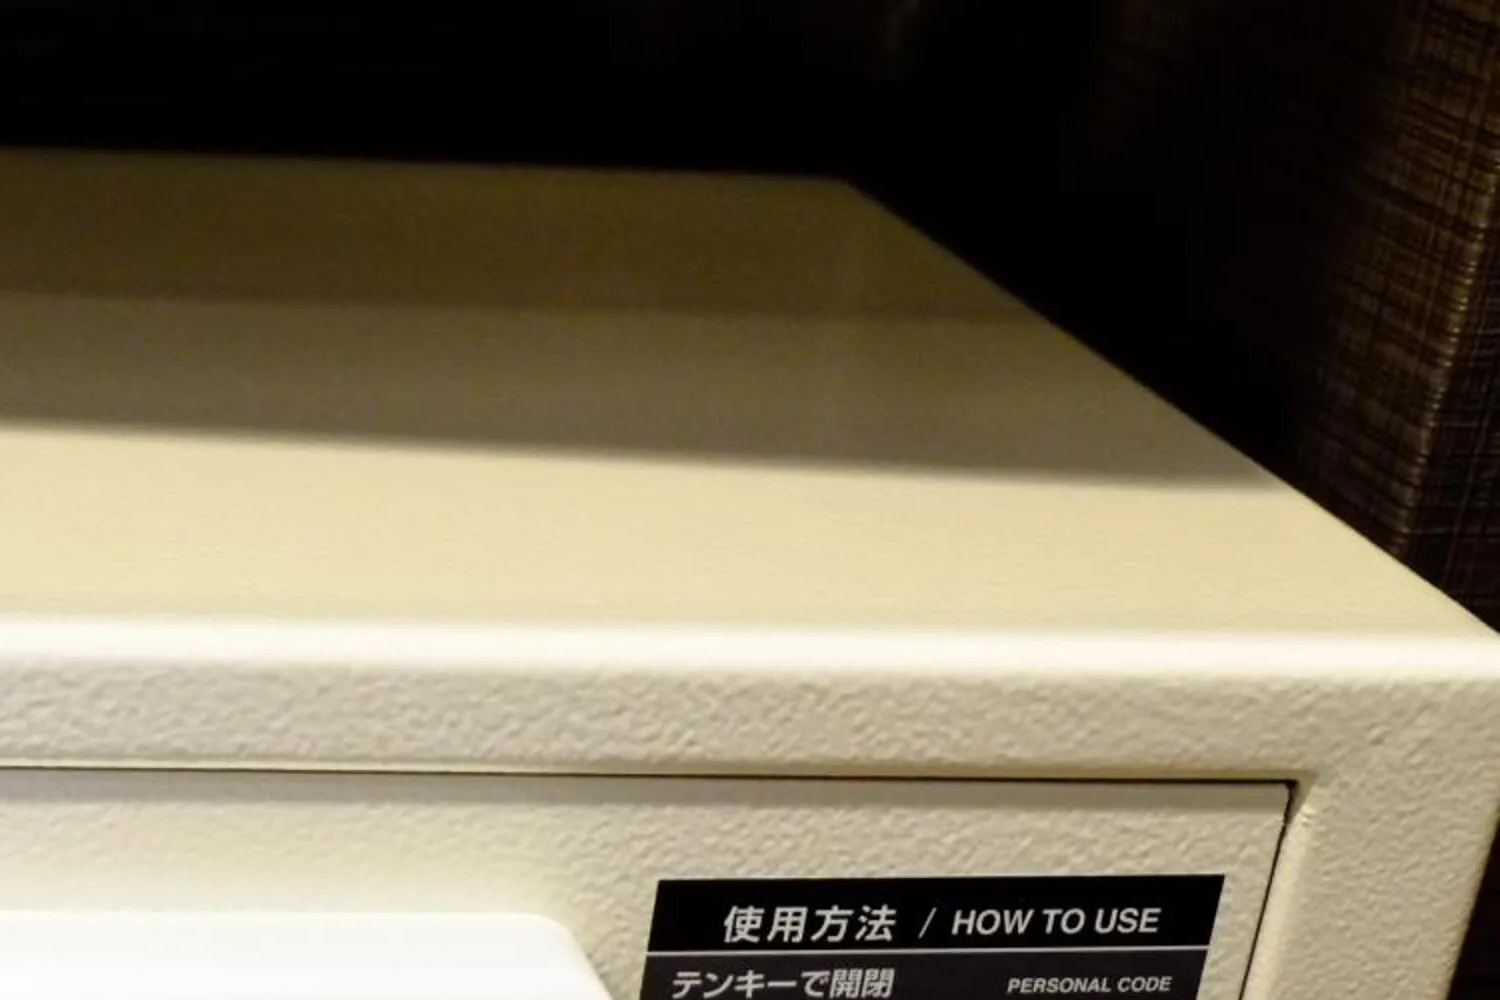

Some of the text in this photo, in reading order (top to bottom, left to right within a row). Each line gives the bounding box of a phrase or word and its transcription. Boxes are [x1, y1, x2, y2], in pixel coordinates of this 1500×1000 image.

[723, 904, 897, 943] 使用方法
[951, 908, 1035, 935] HOW
[1042, 908, 1085, 935] TO
[1094, 907, 1162, 934] USE
[671, 968, 896, 999] テンキーで開閉
[1007, 975, 1173, 994] PERSONAL CODE
